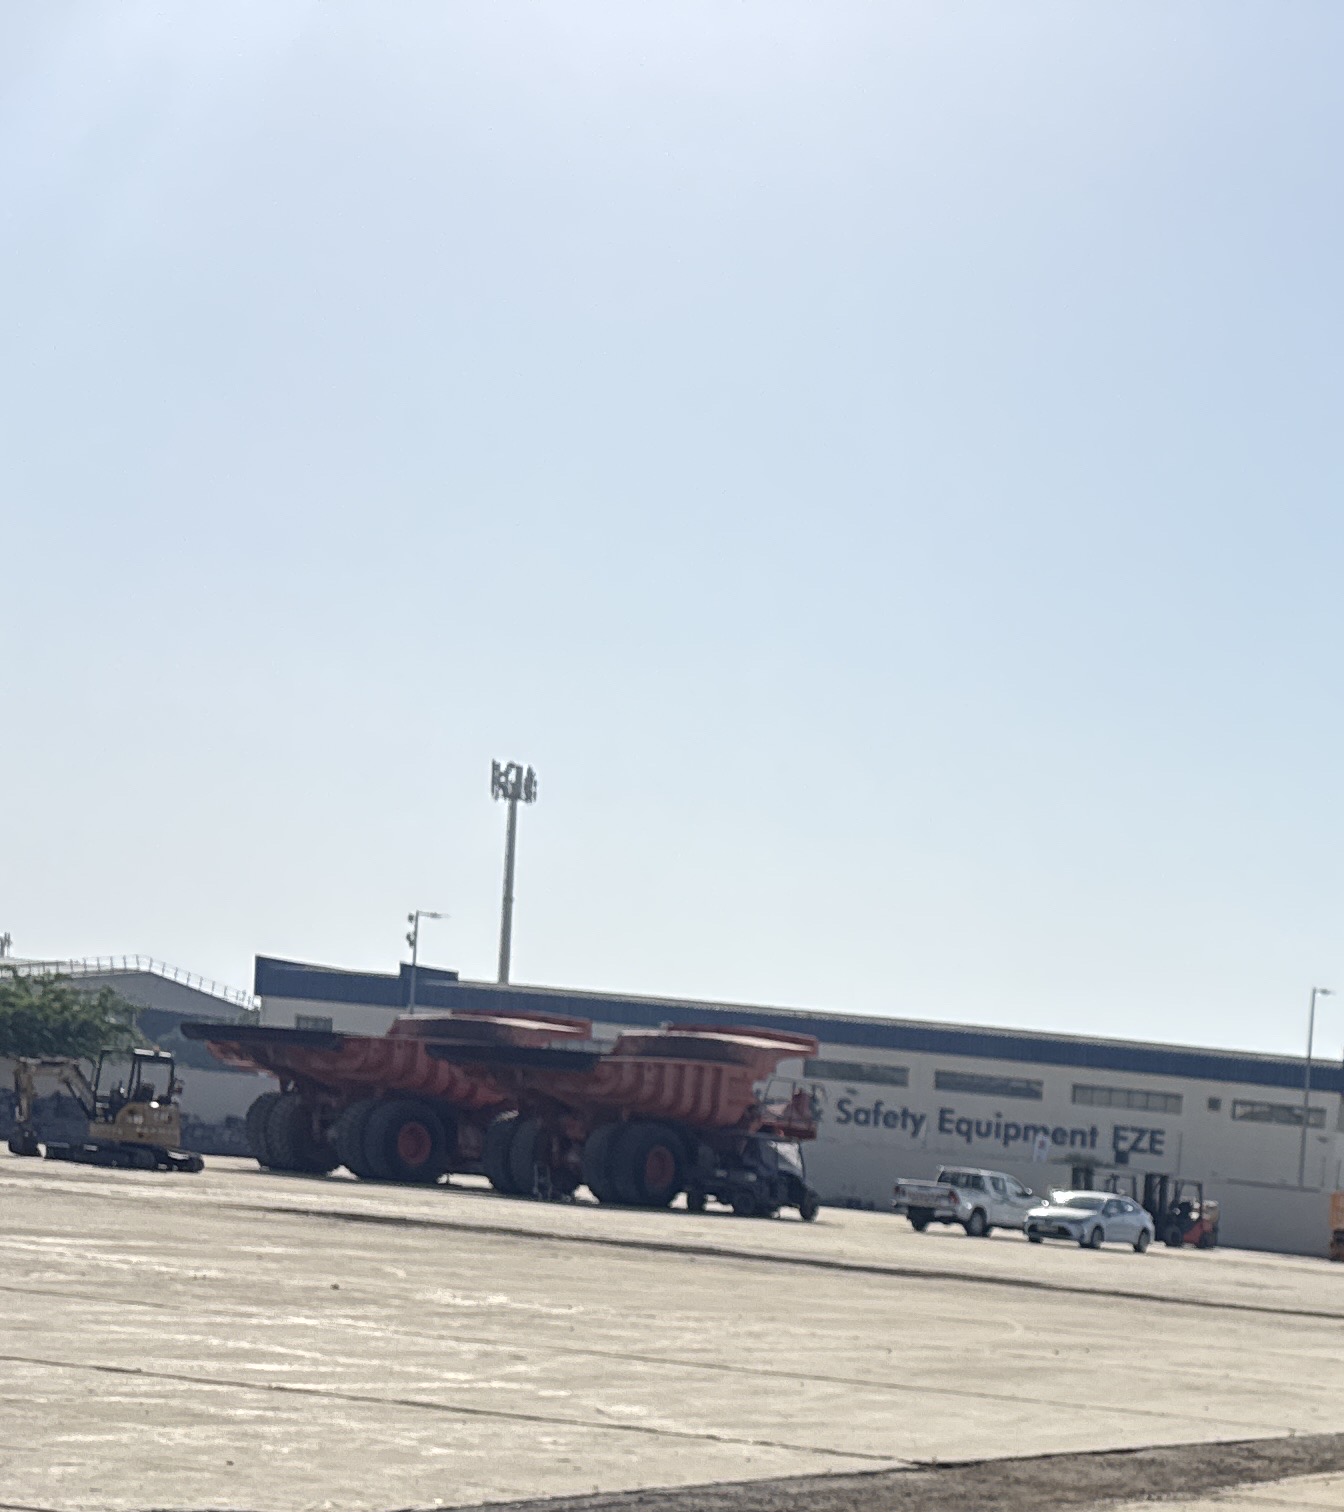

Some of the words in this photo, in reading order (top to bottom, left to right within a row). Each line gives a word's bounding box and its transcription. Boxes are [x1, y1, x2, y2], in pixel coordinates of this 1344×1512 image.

[836, 1097, 926, 1138] Safety
[938, 1106, 1099, 1149] Equipment
[1112, 1124, 1167, 1156] FZE
